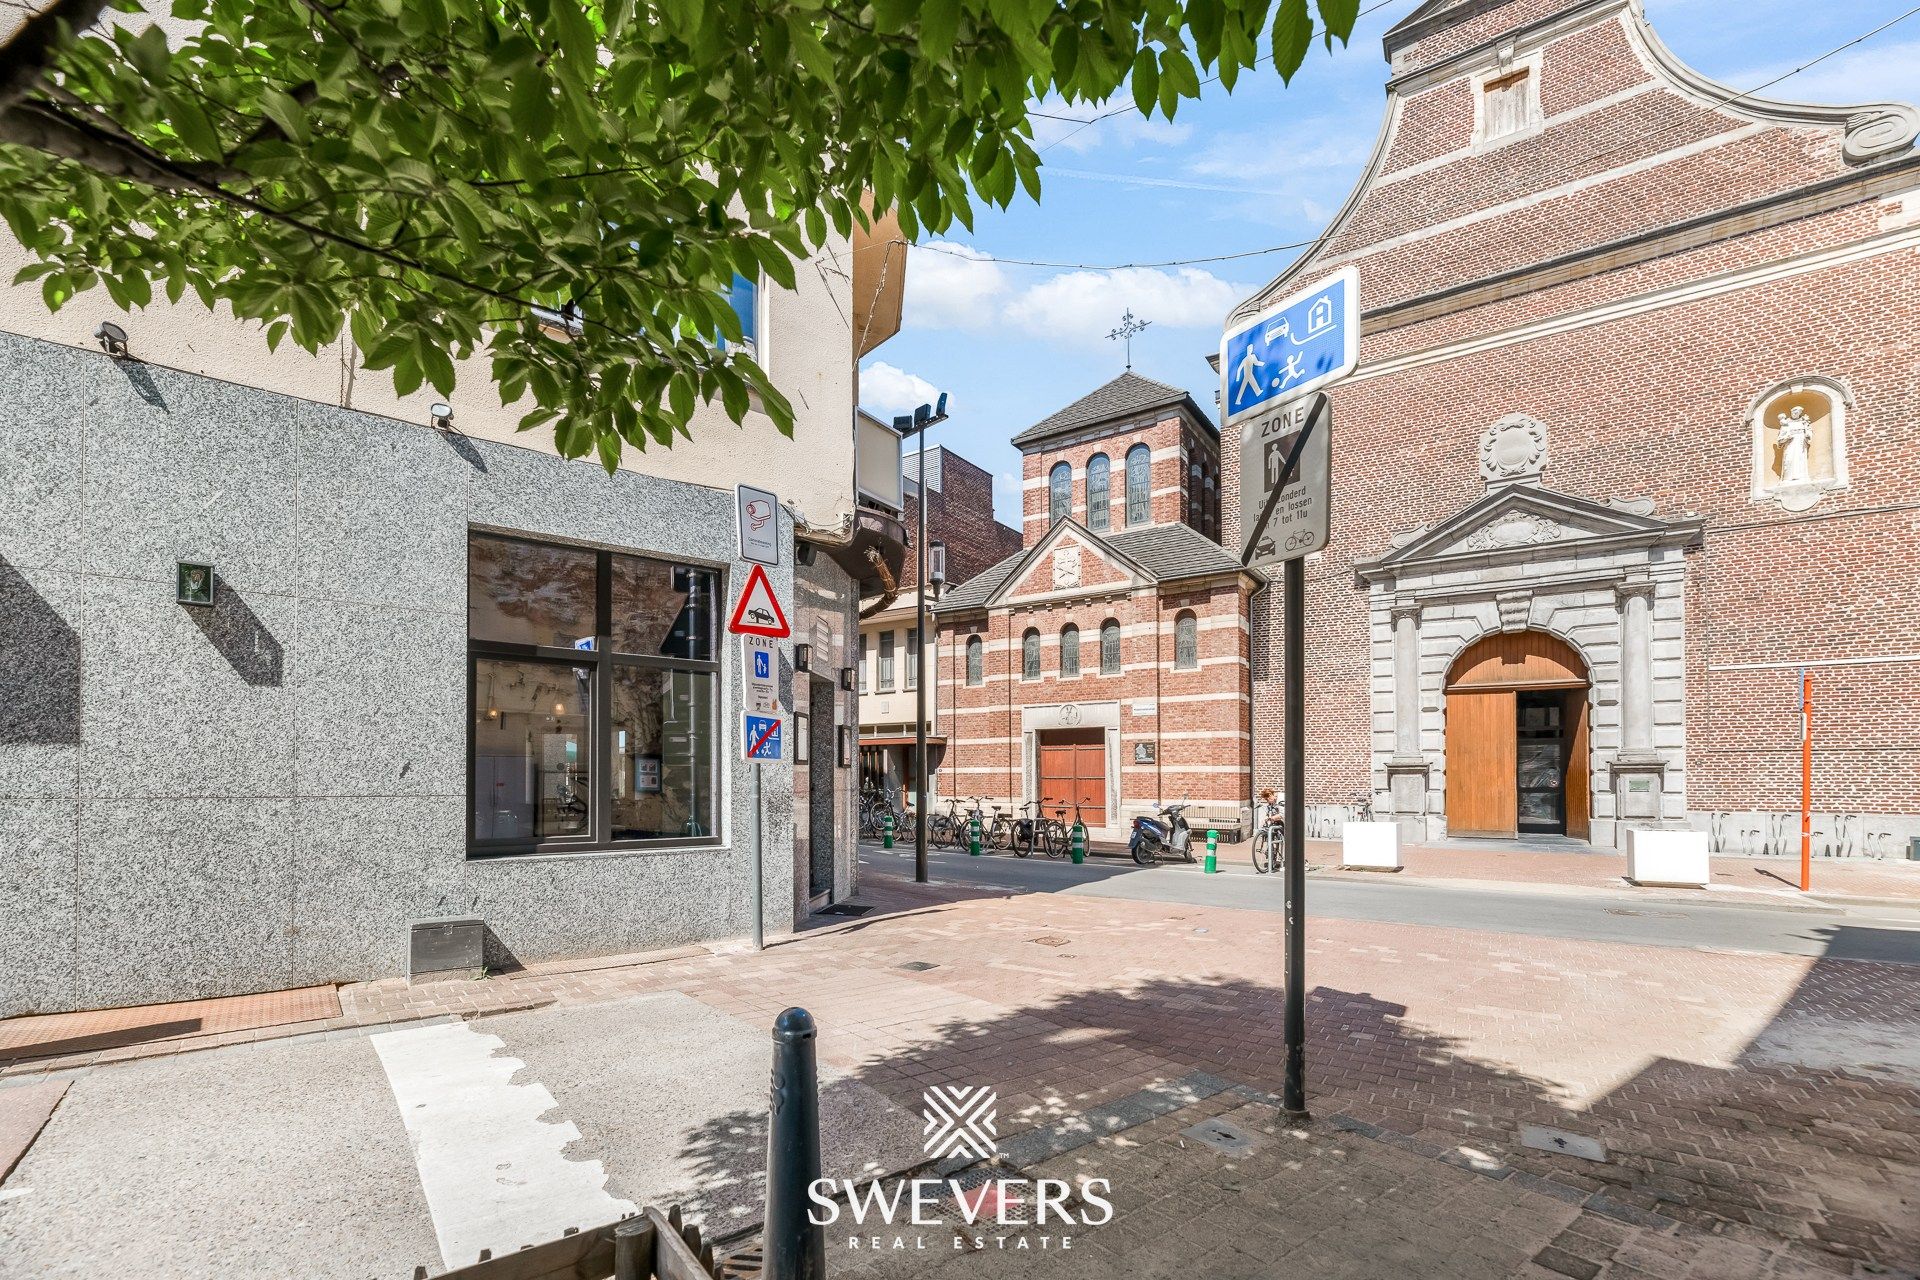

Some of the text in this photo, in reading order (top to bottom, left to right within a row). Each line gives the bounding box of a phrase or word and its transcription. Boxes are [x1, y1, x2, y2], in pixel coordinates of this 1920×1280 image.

[1261, 407, 1304, 438] ZONE
[1275, 497, 1313, 516] en lossen
[1273, 517, 1278, 528] 7
[1282, 513, 1293, 525] tot
[1296, 509, 1308, 520] 11u
[749, 636, 774, 649] ZONE
